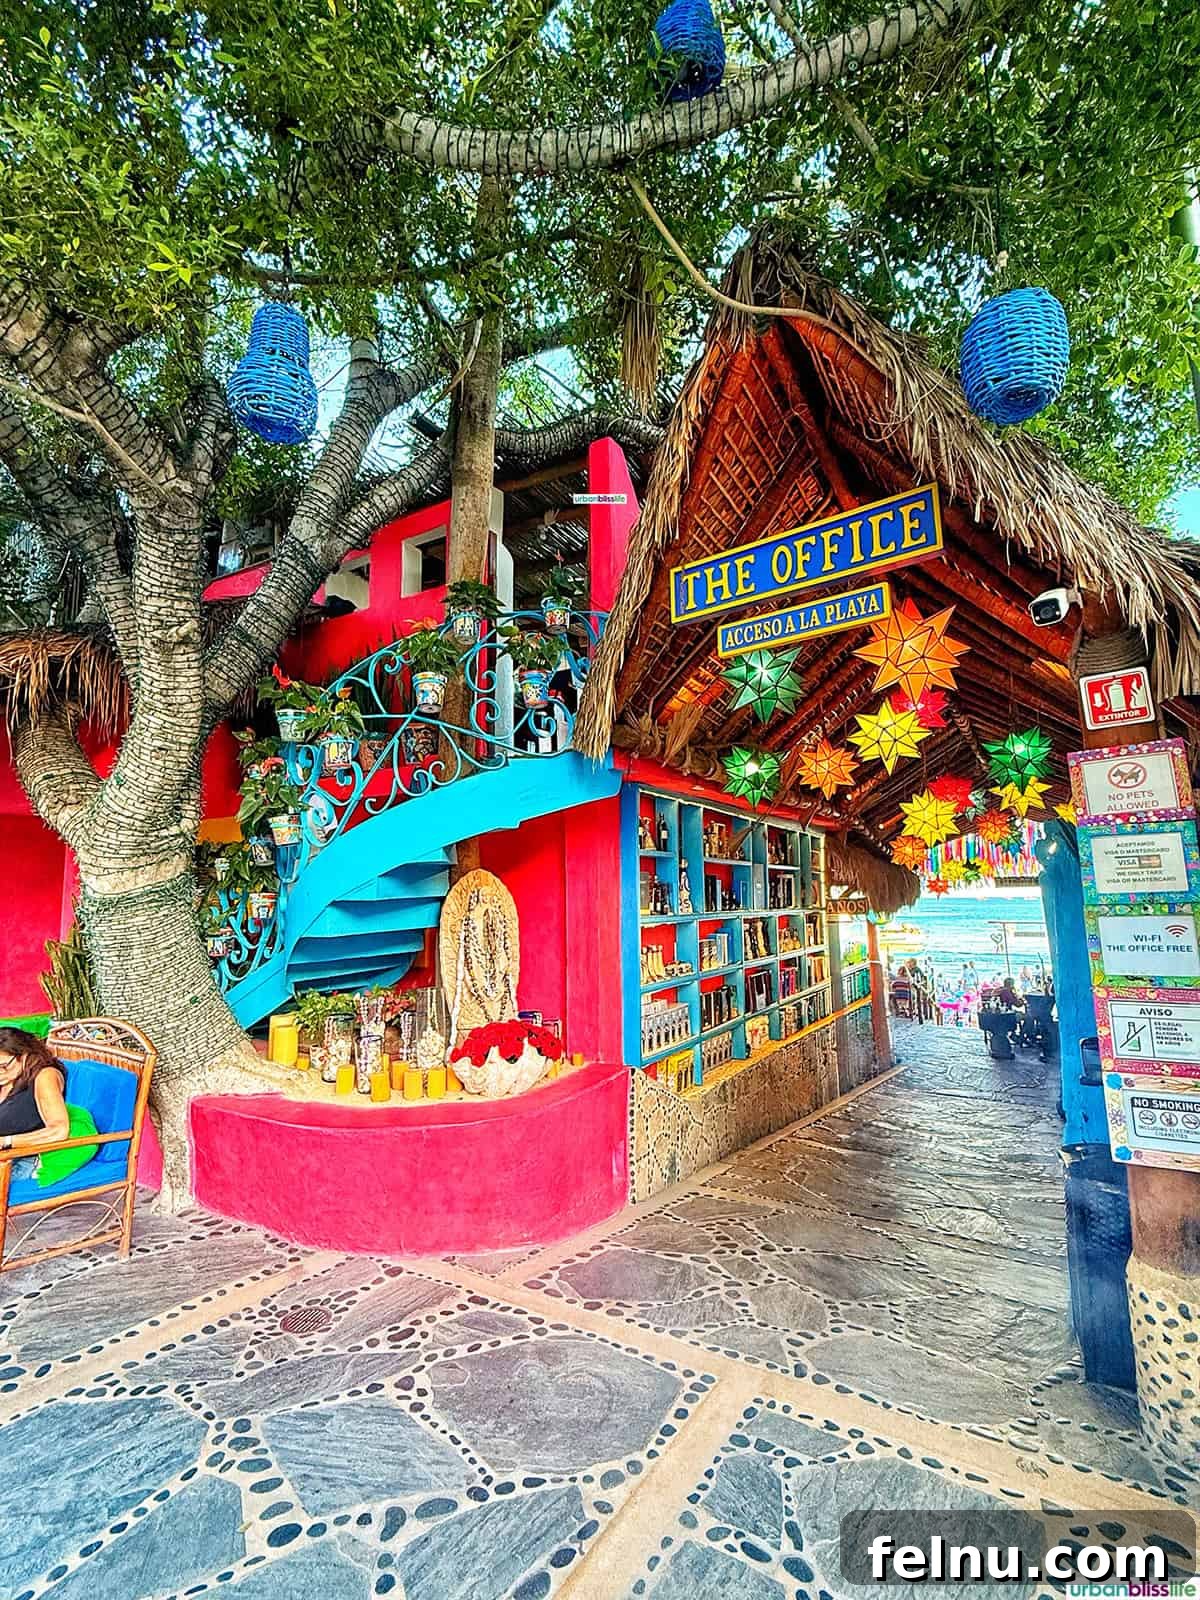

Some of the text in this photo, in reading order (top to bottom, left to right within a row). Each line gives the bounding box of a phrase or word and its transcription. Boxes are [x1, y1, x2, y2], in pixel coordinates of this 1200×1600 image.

[682, 500, 927, 610] THE OFFICE
[725, 594, 880, 648] ACCESO A LA PLAYA
[1098, 709, 1142, 722] EXTINTOR
[1108, 790, 1155, 802] NO PETS
[1107, 800, 1160, 812] ALLOWED
[1139, 1008, 1173, 1016] AVISO
[1134, 1098, 1200, 1112] NO SMOKING
